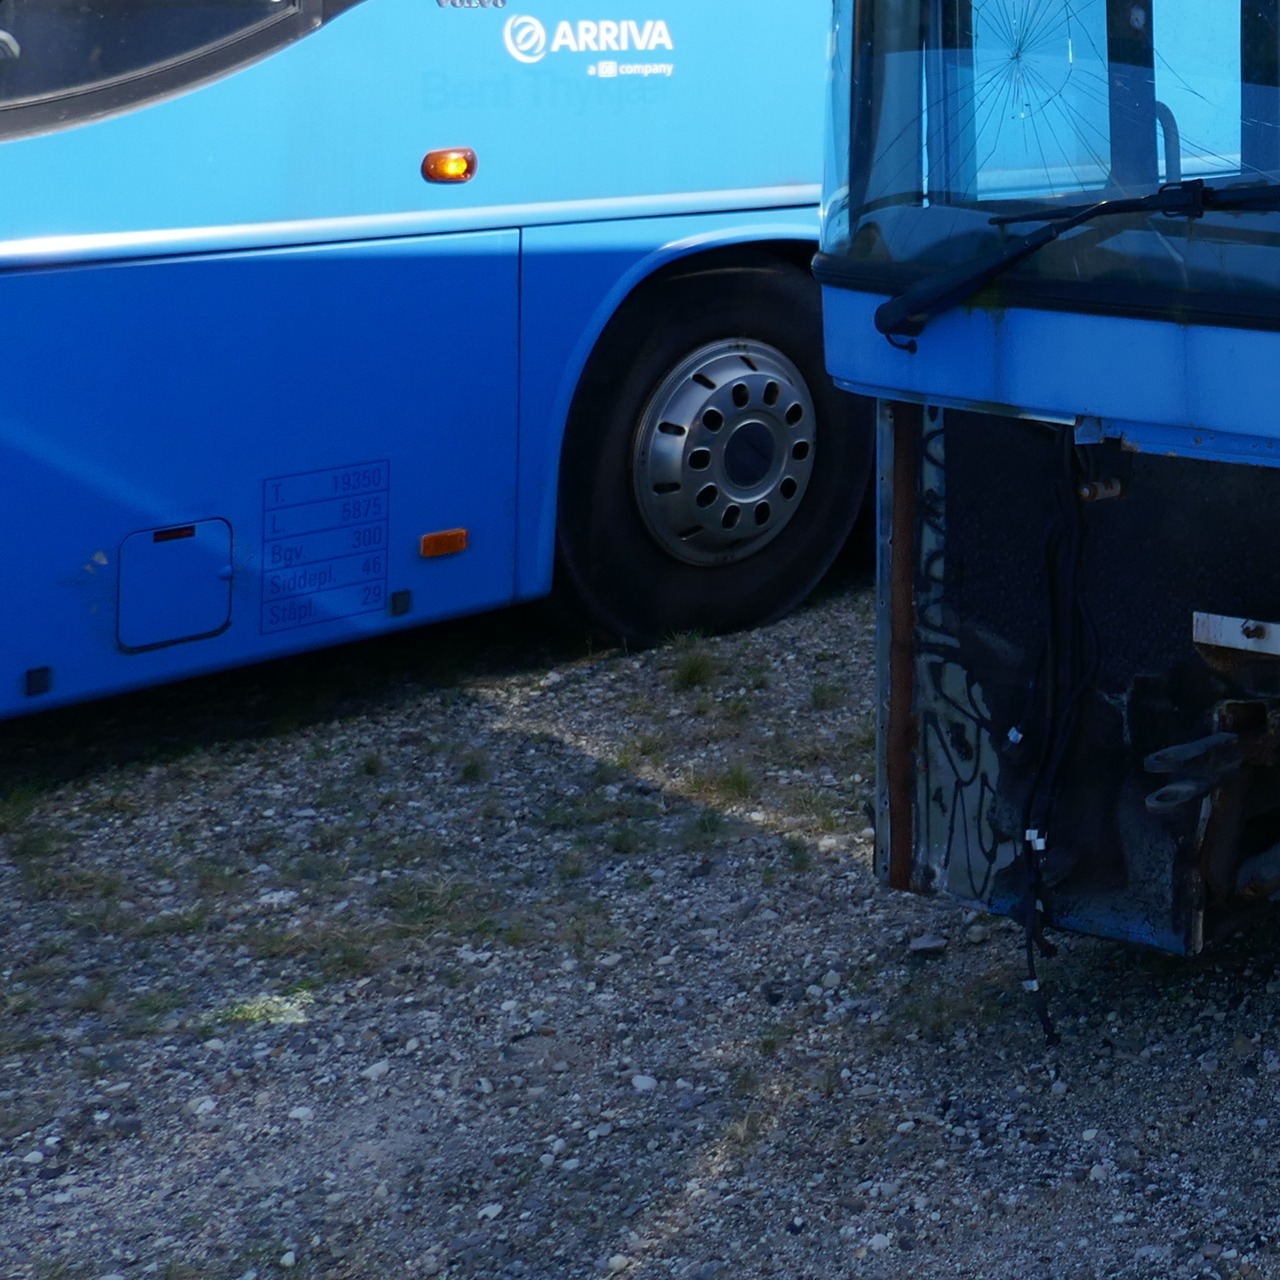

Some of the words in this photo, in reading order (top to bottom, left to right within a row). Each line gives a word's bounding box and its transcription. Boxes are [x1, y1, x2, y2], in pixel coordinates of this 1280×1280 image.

[551, 20, 674, 52] ARRIVA
[587, 64, 597, 76] a
[599, 62, 617, 77] DB
[620, 63, 674, 77] company
[271, 483, 286, 503] T.
[333, 468, 382, 493] 19350
[271, 514, 286, 534] L.
[342, 497, 382, 521] 5875
[352, 527, 382, 549] 300
[270, 565, 337, 595] Siddepl.
[362, 556, 382, 575] 46
[362, 586, 381, 605] 29
